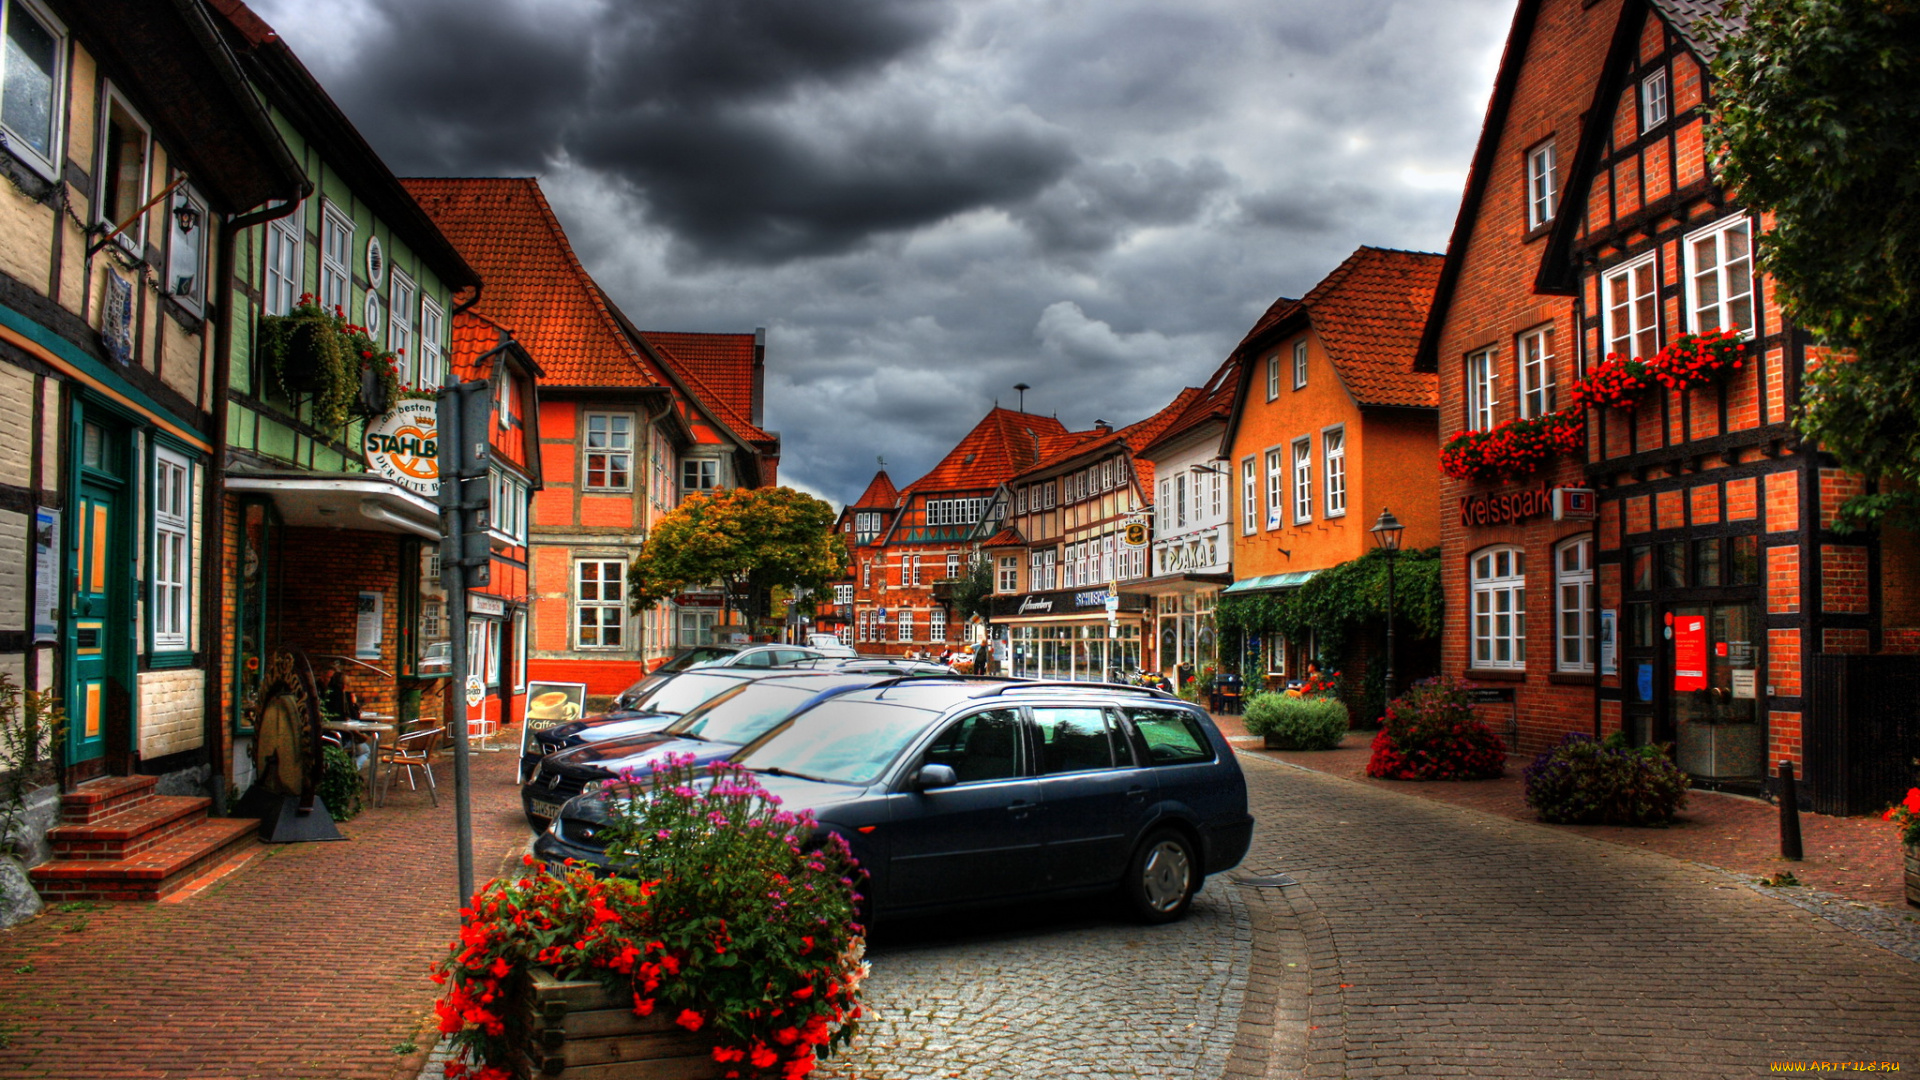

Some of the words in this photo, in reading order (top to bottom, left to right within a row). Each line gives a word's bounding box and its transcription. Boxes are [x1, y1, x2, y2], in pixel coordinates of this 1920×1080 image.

[397, 403, 431, 414] besten
[367, 433, 438, 459] STAHLB
[376, 455, 395, 478] DER
[396, 476, 427, 492] GUTE
[1459, 480, 1586, 526] Kreisspark
[1170, 545, 1207, 571] PLAKA
